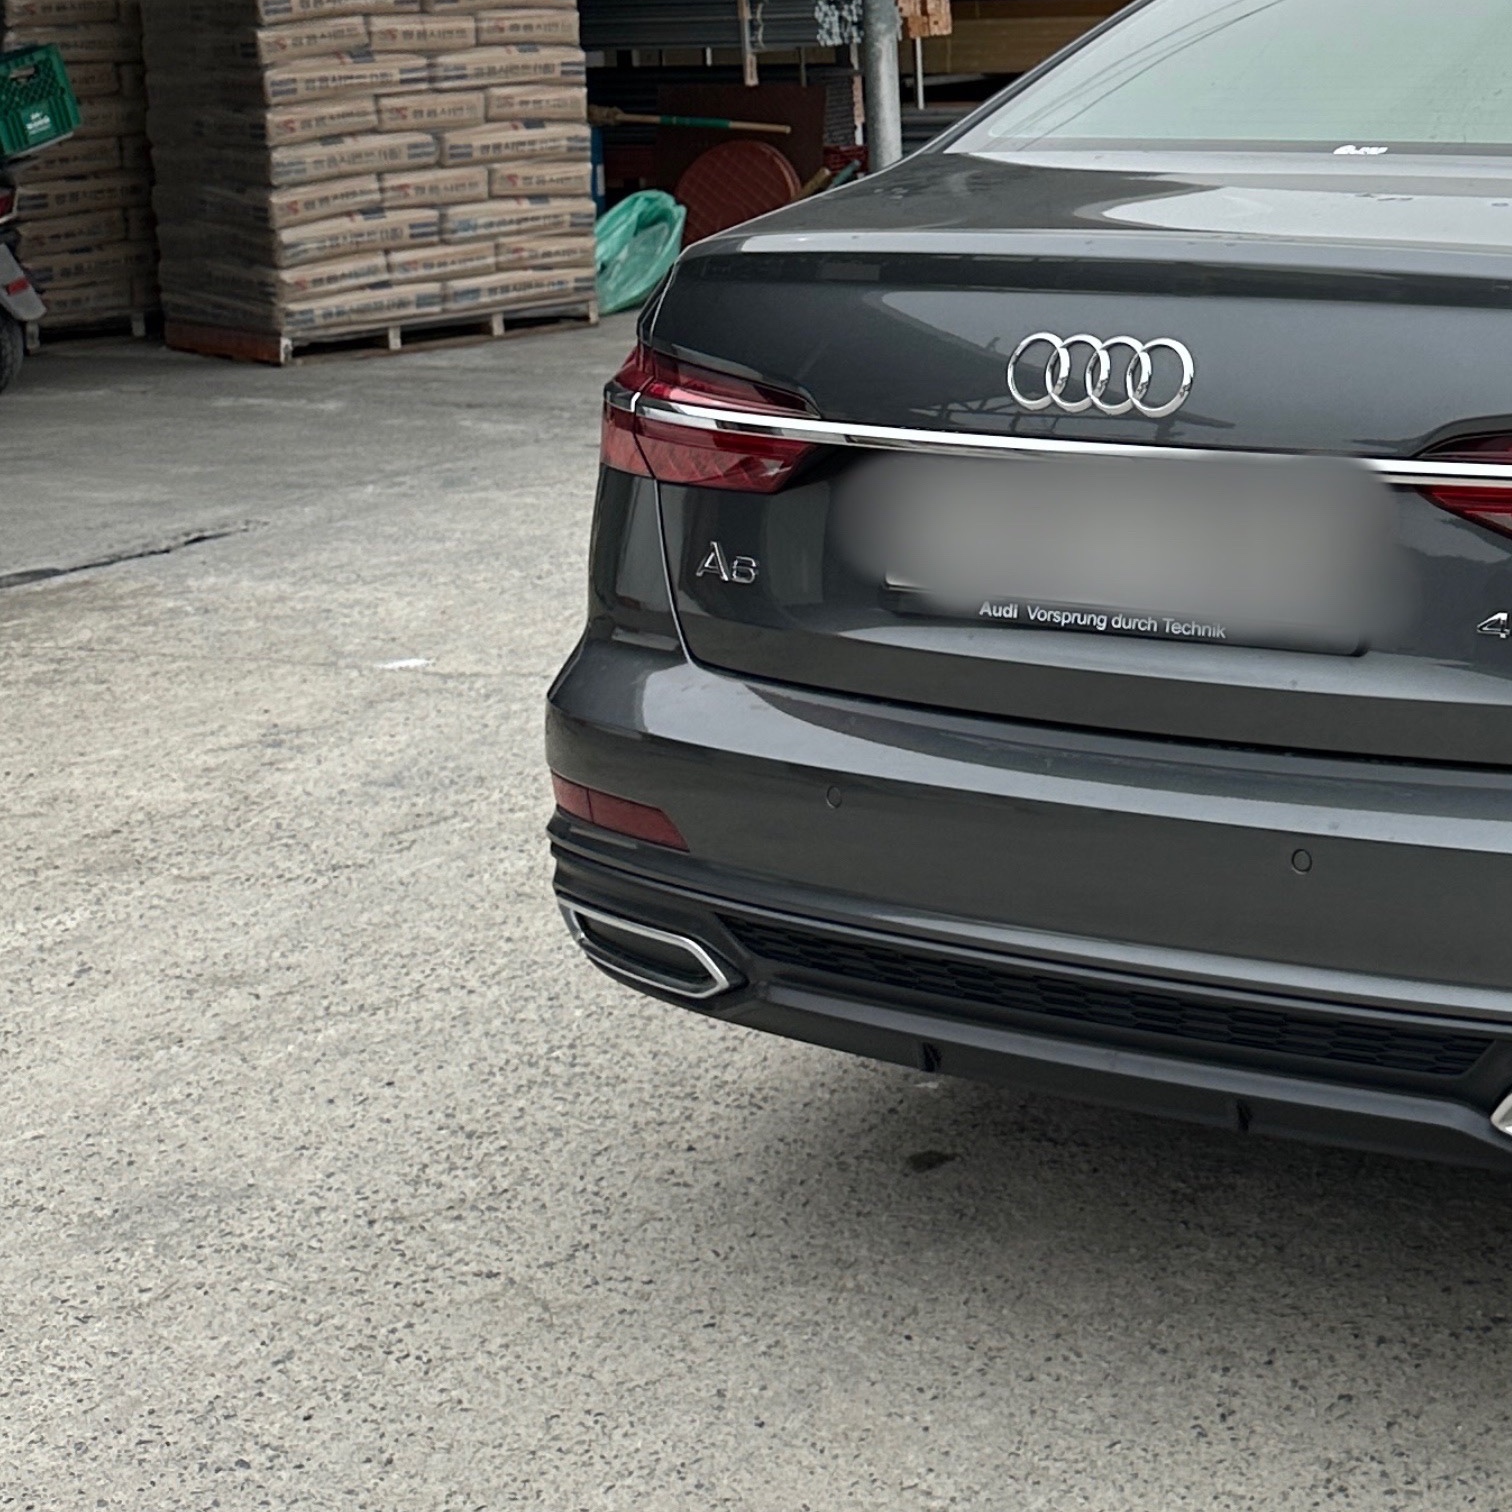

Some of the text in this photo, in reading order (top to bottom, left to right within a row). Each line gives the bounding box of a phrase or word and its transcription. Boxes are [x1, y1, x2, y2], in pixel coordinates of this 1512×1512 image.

[696, 541, 758, 583] A6
[979, 601, 1226, 639] Audi Vorsprung durch Technik
